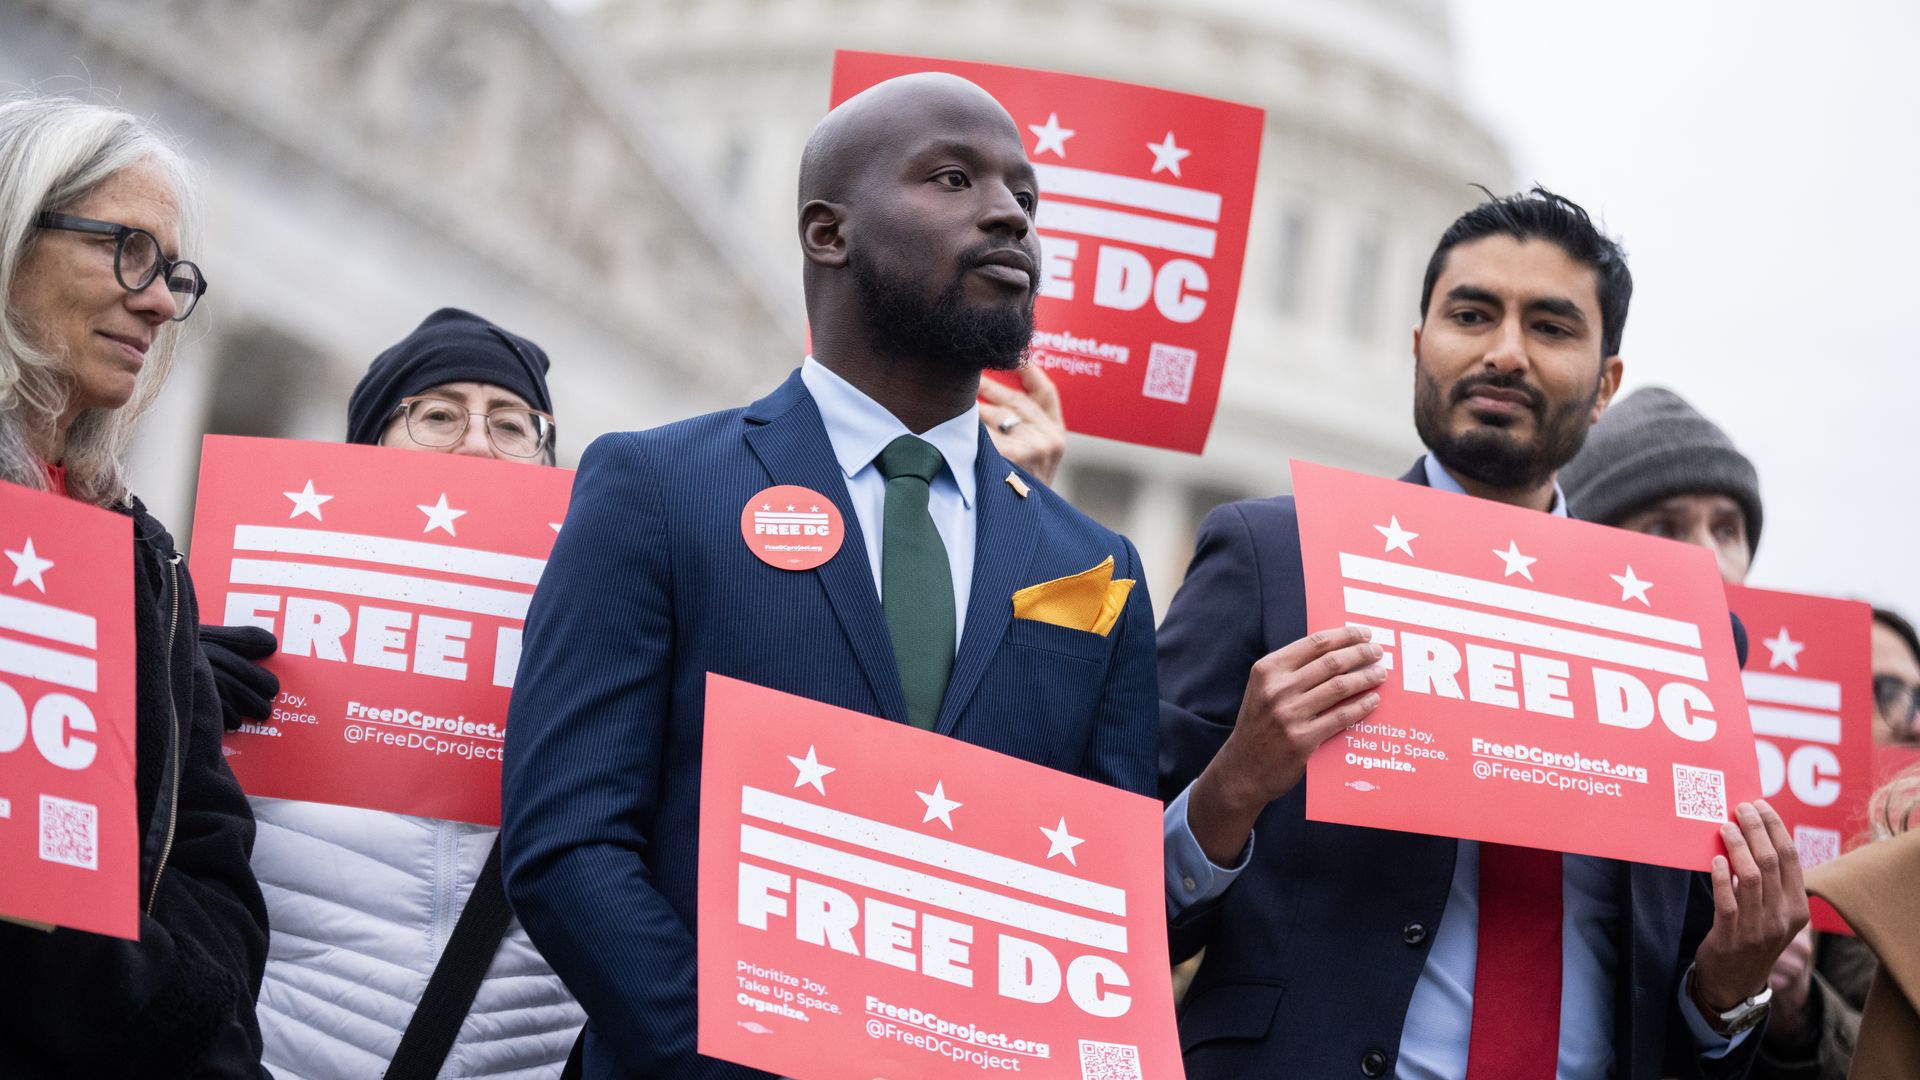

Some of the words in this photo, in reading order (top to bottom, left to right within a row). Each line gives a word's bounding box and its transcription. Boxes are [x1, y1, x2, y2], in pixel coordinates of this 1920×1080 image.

[1093, 245, 1209, 323] DC
[1031, 349, 1102, 377] Cproject
[754, 524, 801, 535] FREE
[803, 525, 830, 536] DC
[272, 708, 319, 725] Space.
[280, 692, 307, 708] Joy.
[1591, 666, 1718, 742] DC
[226, 722, 282, 737] anize.
[346, 701, 506, 741] FreeDCproject.
[1409, 728, 1435, 744] Joy.
[344, 724, 504, 761] @FreeDCproject
[1345, 736, 1378, 751] Take
[1381, 740, 1401, 756] Up
[1404, 744, 1449, 761] Space.
[1472, 737, 1648, 783] FreeDCproject.org
[1345, 752, 1416, 773] Organize.
[1473, 760, 1622, 797] @FreeDCproject
[738, 861, 974, 988] FREE
[998, 933, 1132, 1018] DC
[737, 960, 799, 987] Prioritize
[801, 978, 829, 996] Joy.
[737, 975, 770, 995] Take
[773, 986, 794, 1003] Up
[796, 993, 842, 1015] Space.
[737, 993, 809, 1022] Organize.
[865, 995, 1051, 1058] FreeDCproject.org
[866, 1019, 1021, 1071] @FreeDCproject
